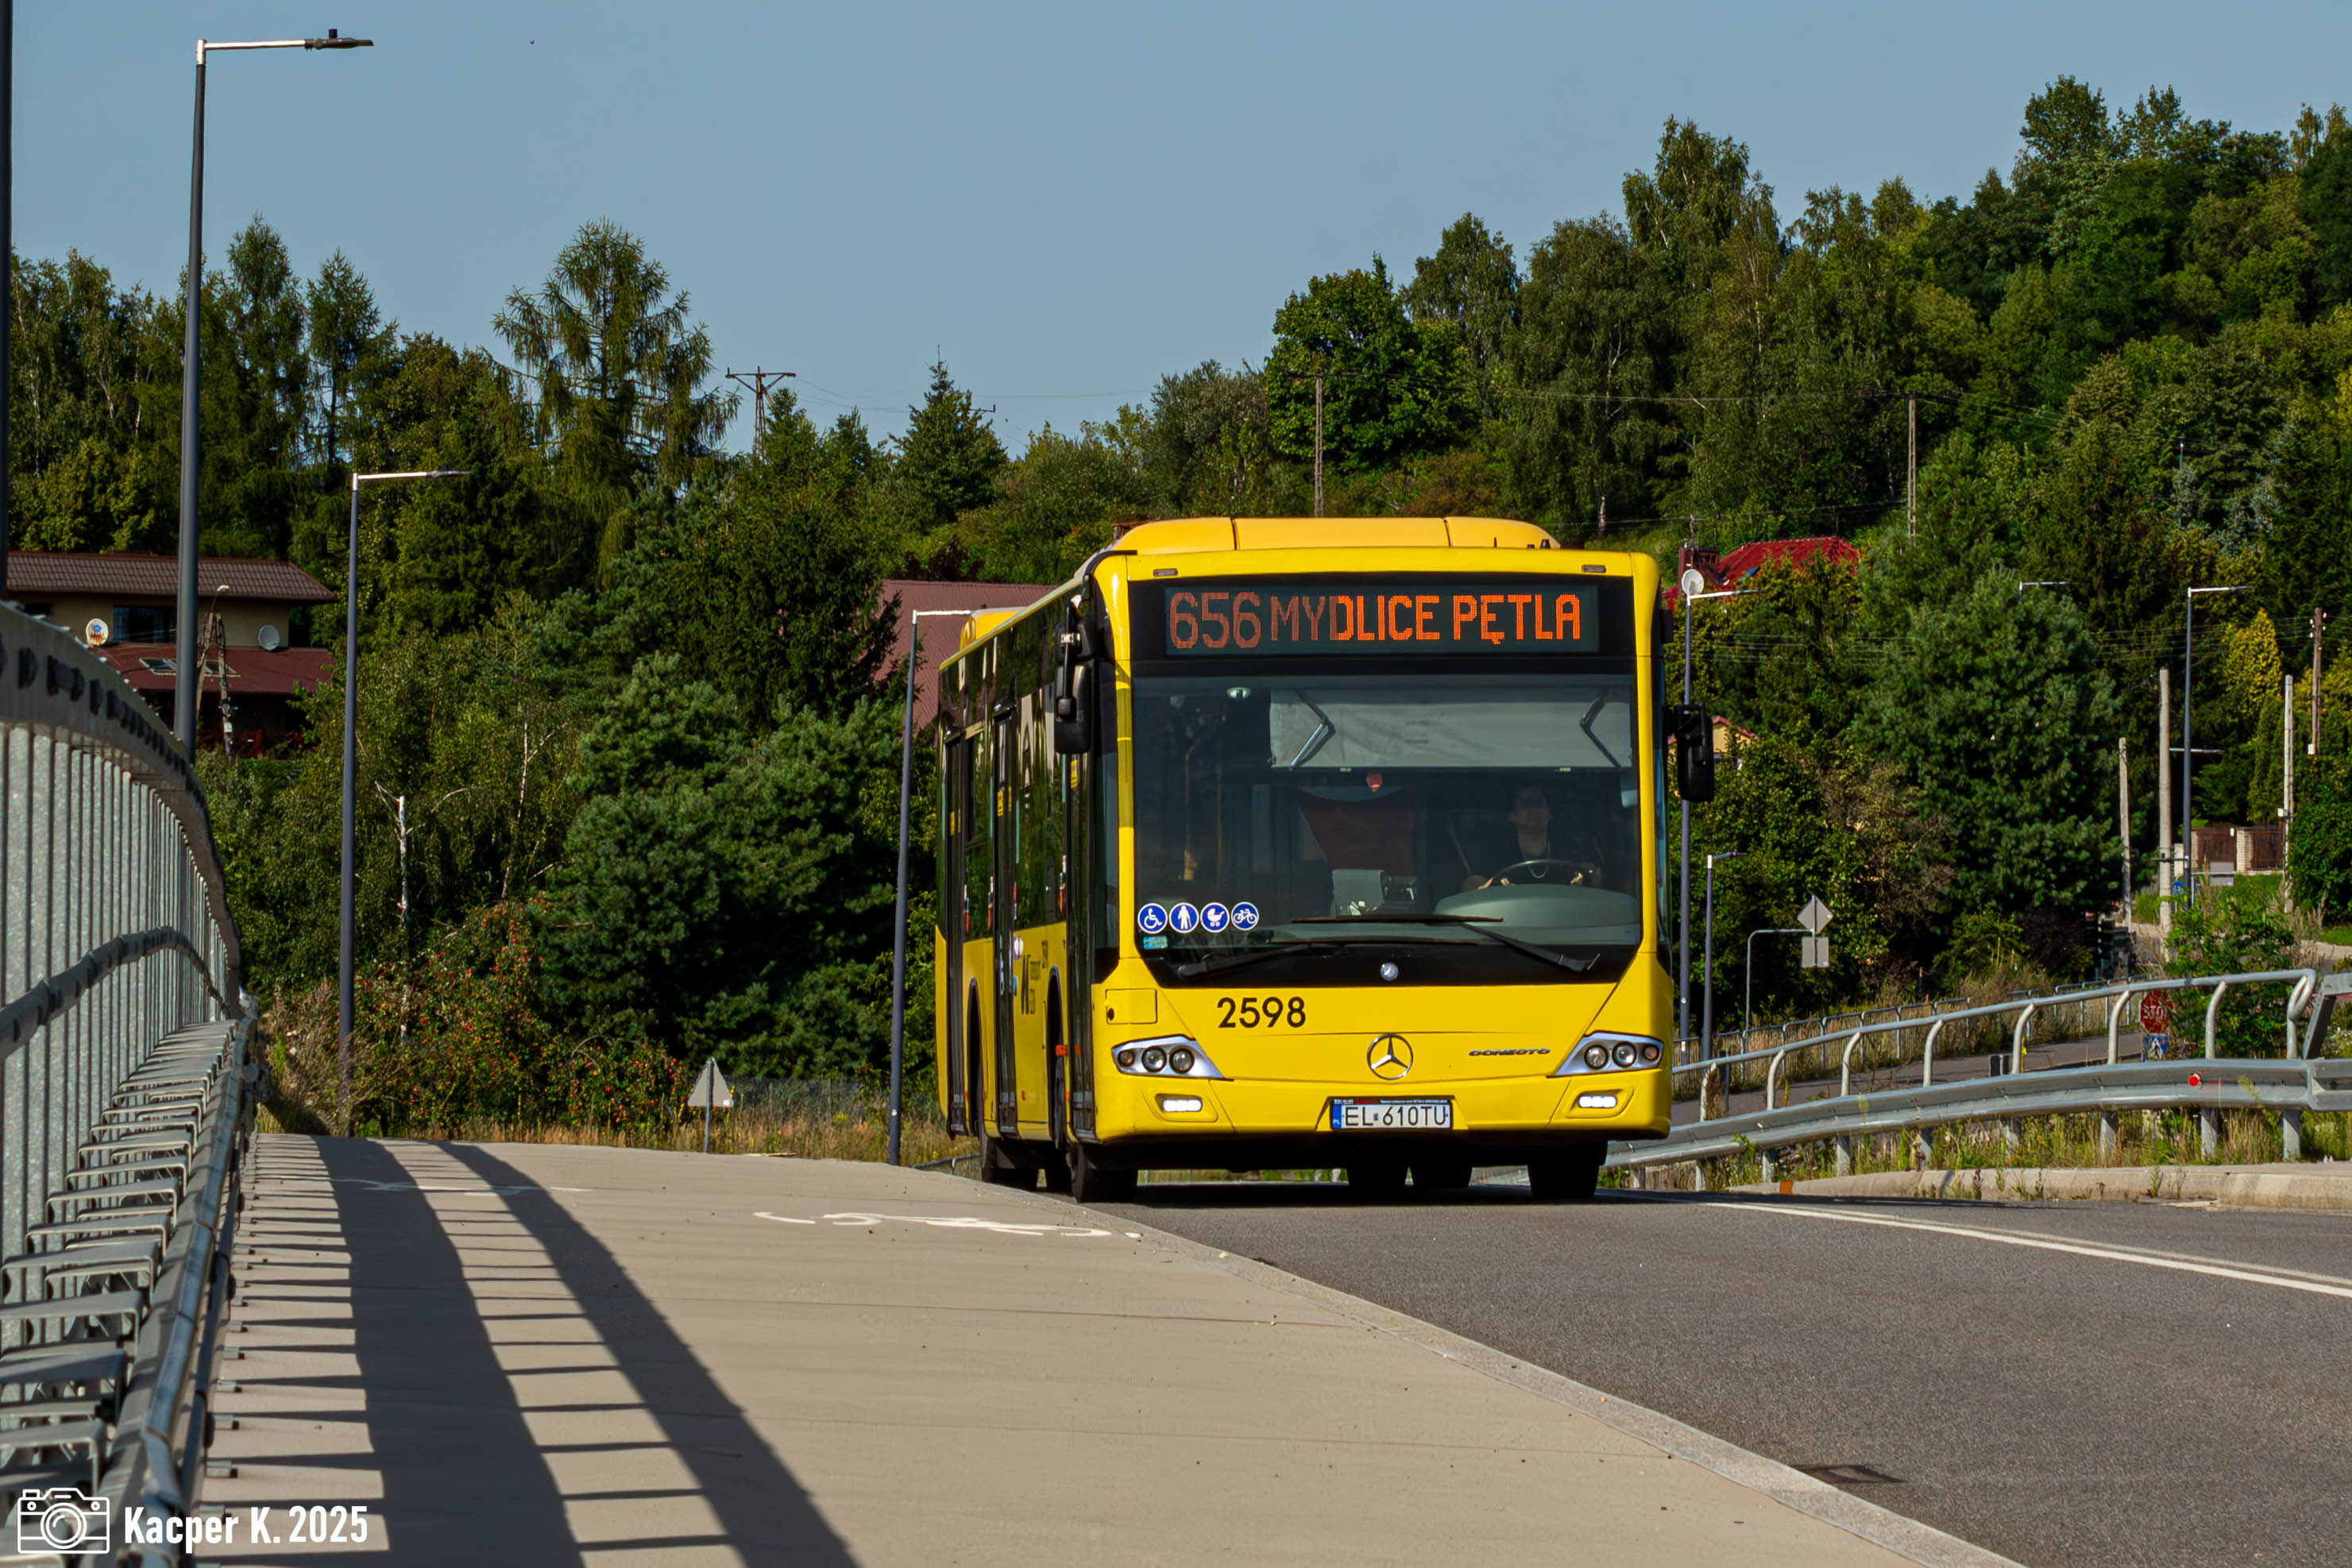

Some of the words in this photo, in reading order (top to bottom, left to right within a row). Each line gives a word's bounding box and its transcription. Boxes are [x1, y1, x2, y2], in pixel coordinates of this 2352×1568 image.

[1169, 592, 1261, 648] 656
[1271, 594, 1440, 642] MYDLICE
[1453, 594, 1581, 645] PĘTLA
[1217, 996, 1307, 1029] 2598
[1345, 1106, 1373, 1126] EL
[1382, 1106, 1446, 1126] 610TU
